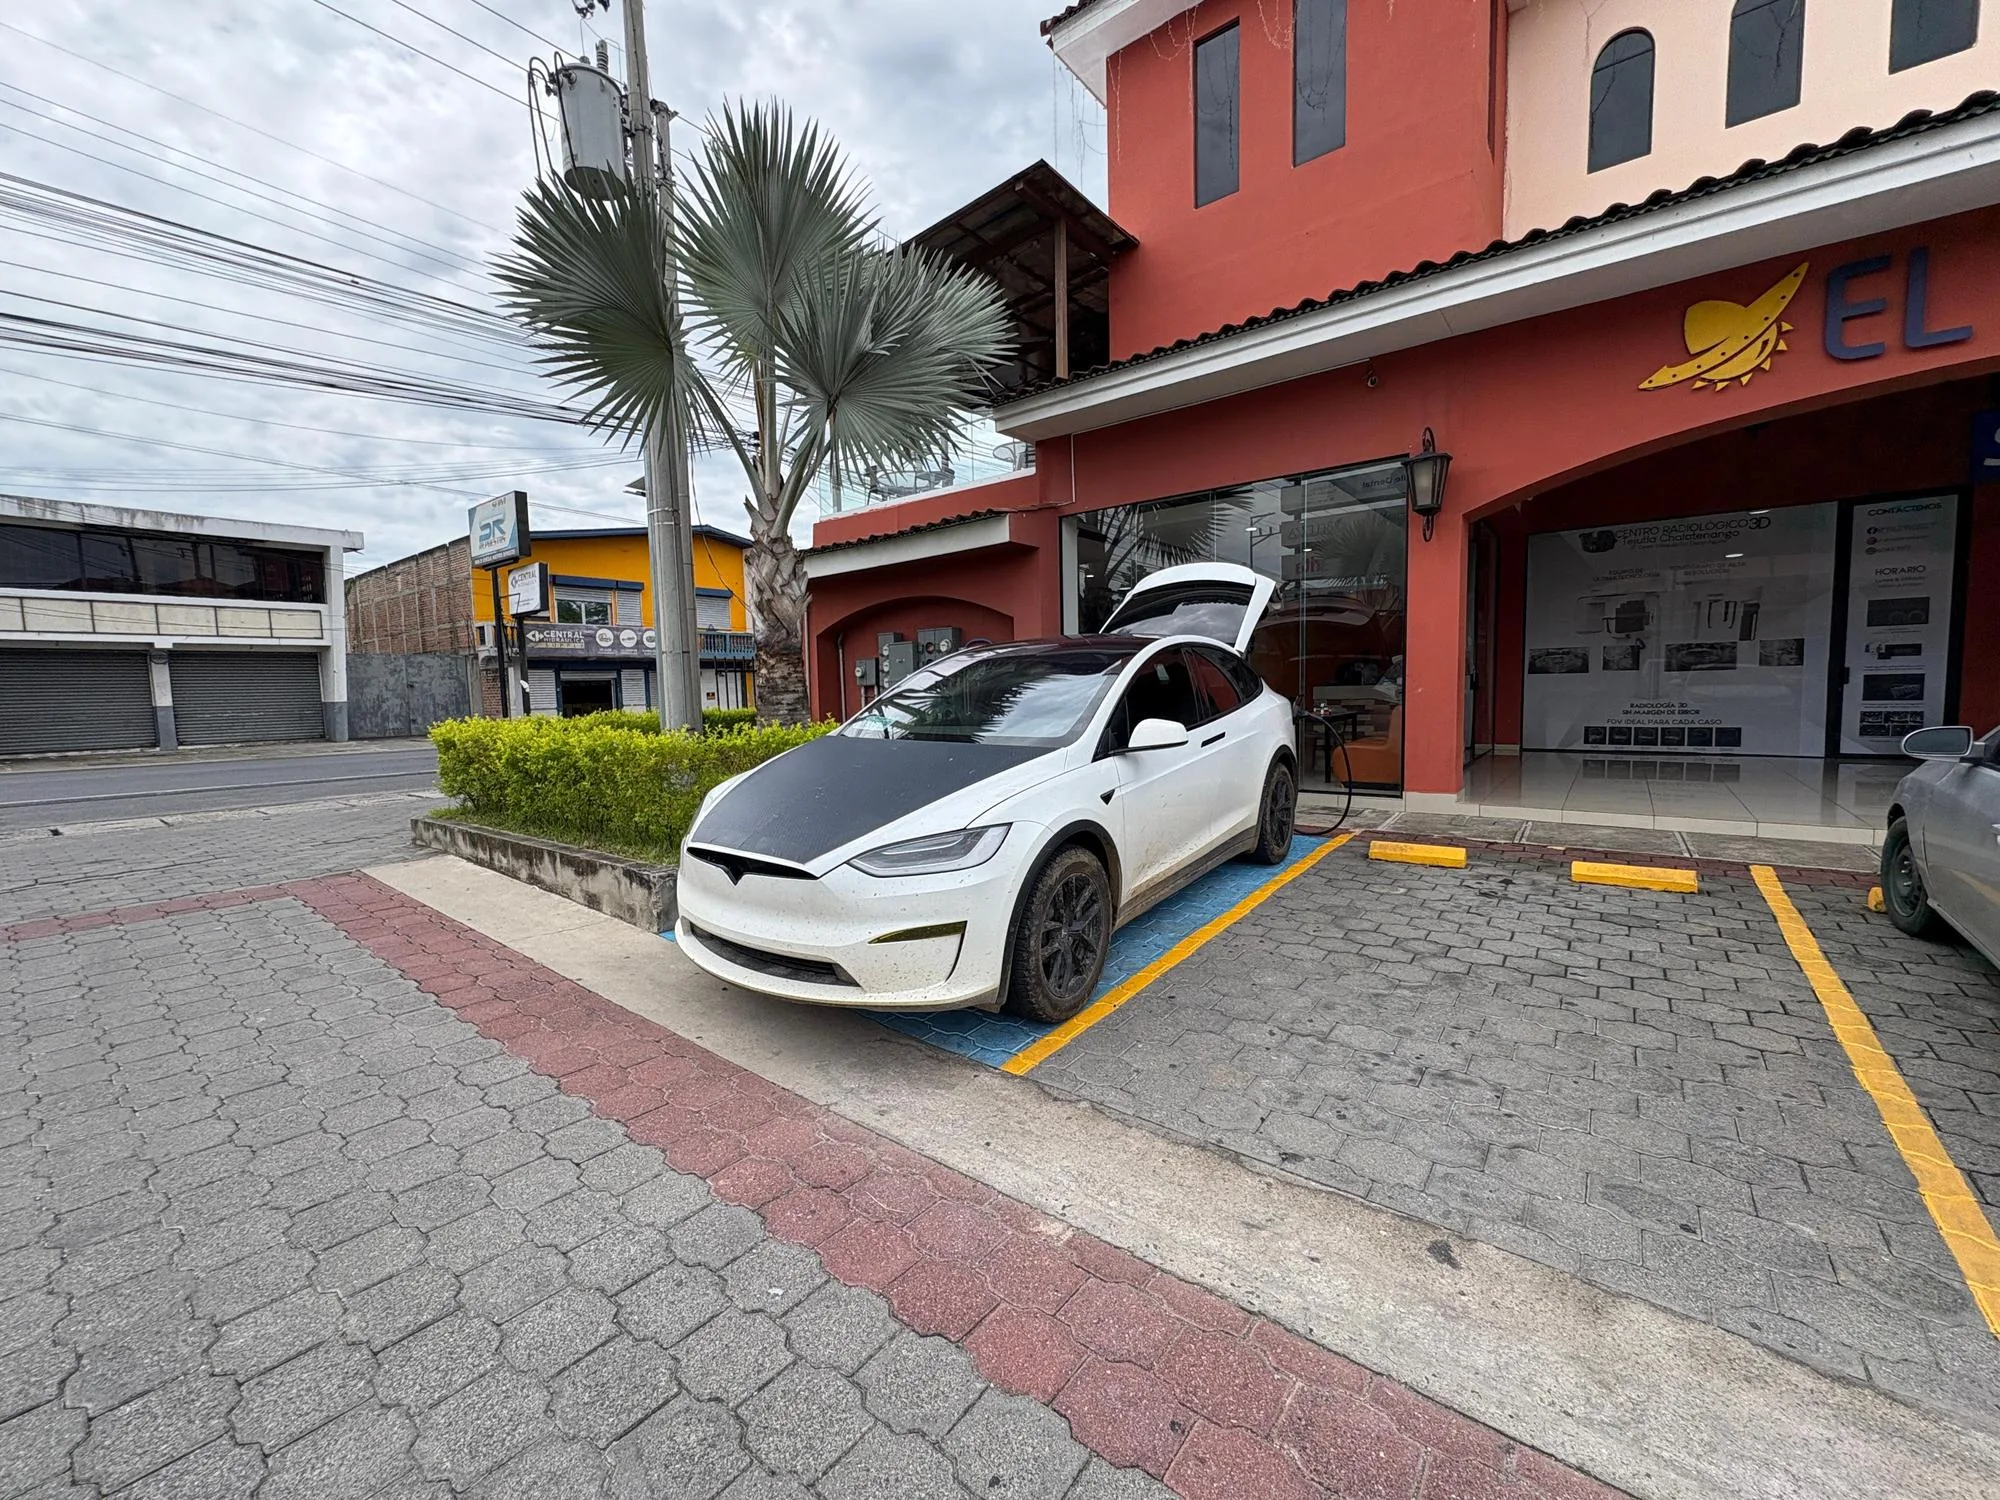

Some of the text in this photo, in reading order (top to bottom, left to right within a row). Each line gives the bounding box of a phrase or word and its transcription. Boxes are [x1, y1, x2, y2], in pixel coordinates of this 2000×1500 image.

[1825, 246, 1973, 359] EL
[1616, 526, 1659, 538] CENTRO
[1749, 516, 1771, 530] 3D
[1660, 530, 1740, 542] Chalatenango
[1875, 565, 1926, 576] HORARIO
[543, 629, 584, 641] CENTRAL
[1647, 718, 1671, 726] PARA
[1672, 718, 1696, 726] CADA
[1697, 718, 1722, 726] CASO
